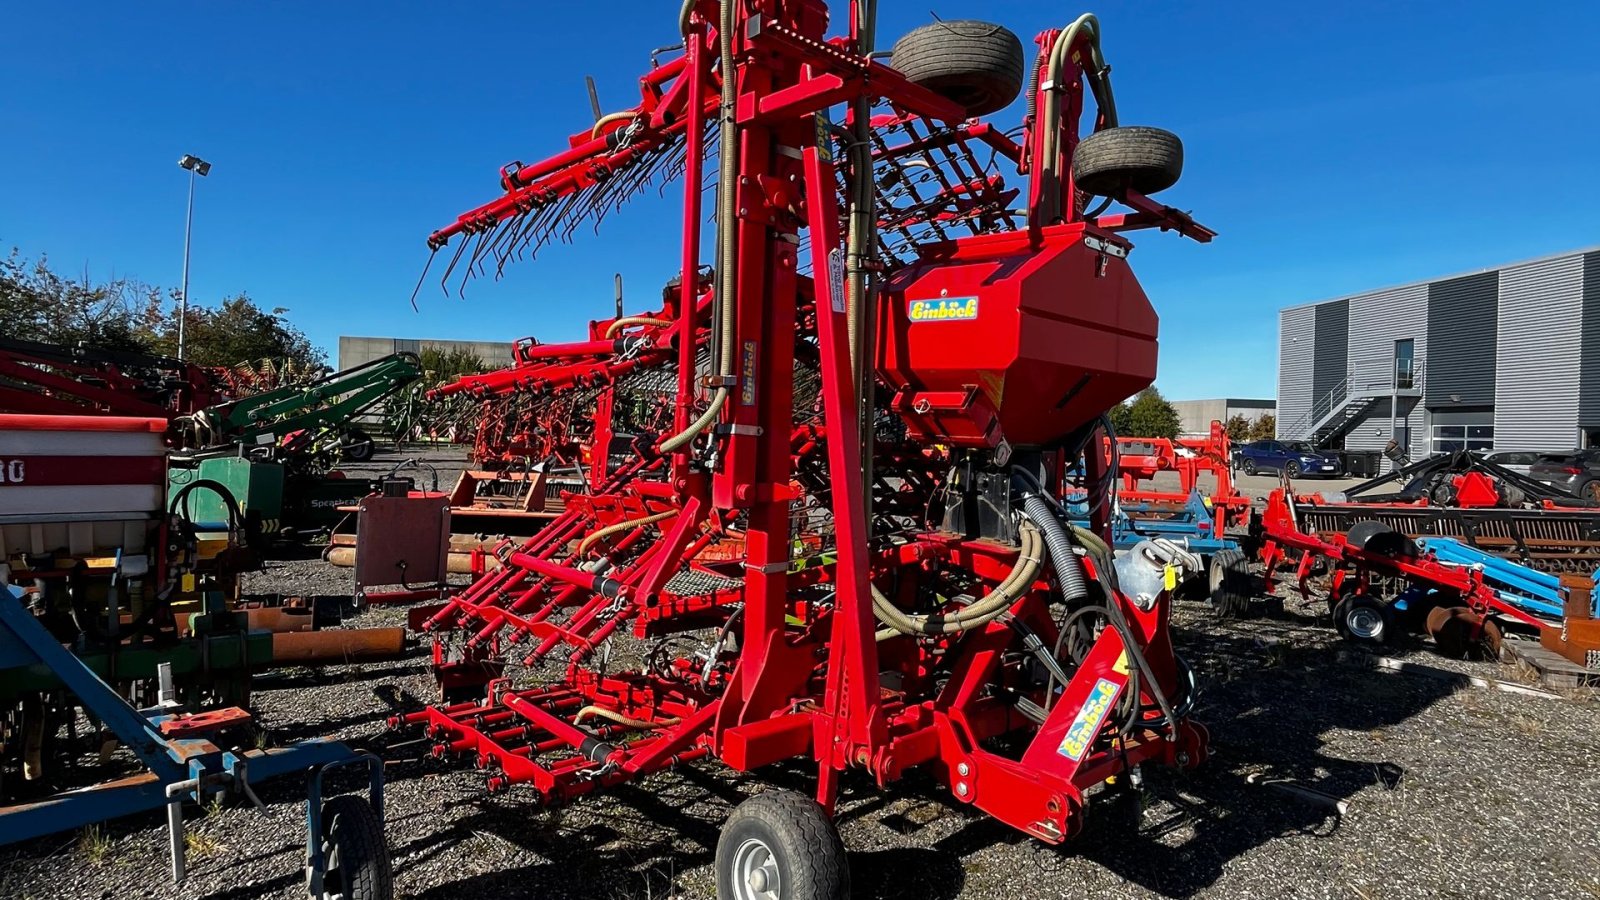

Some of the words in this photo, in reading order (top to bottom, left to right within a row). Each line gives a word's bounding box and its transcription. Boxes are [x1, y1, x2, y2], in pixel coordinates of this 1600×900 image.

[911, 299, 976, 319] Einböck
[742, 342, 754, 403] Einböck
[1063, 681, 1117, 757] Einböck
